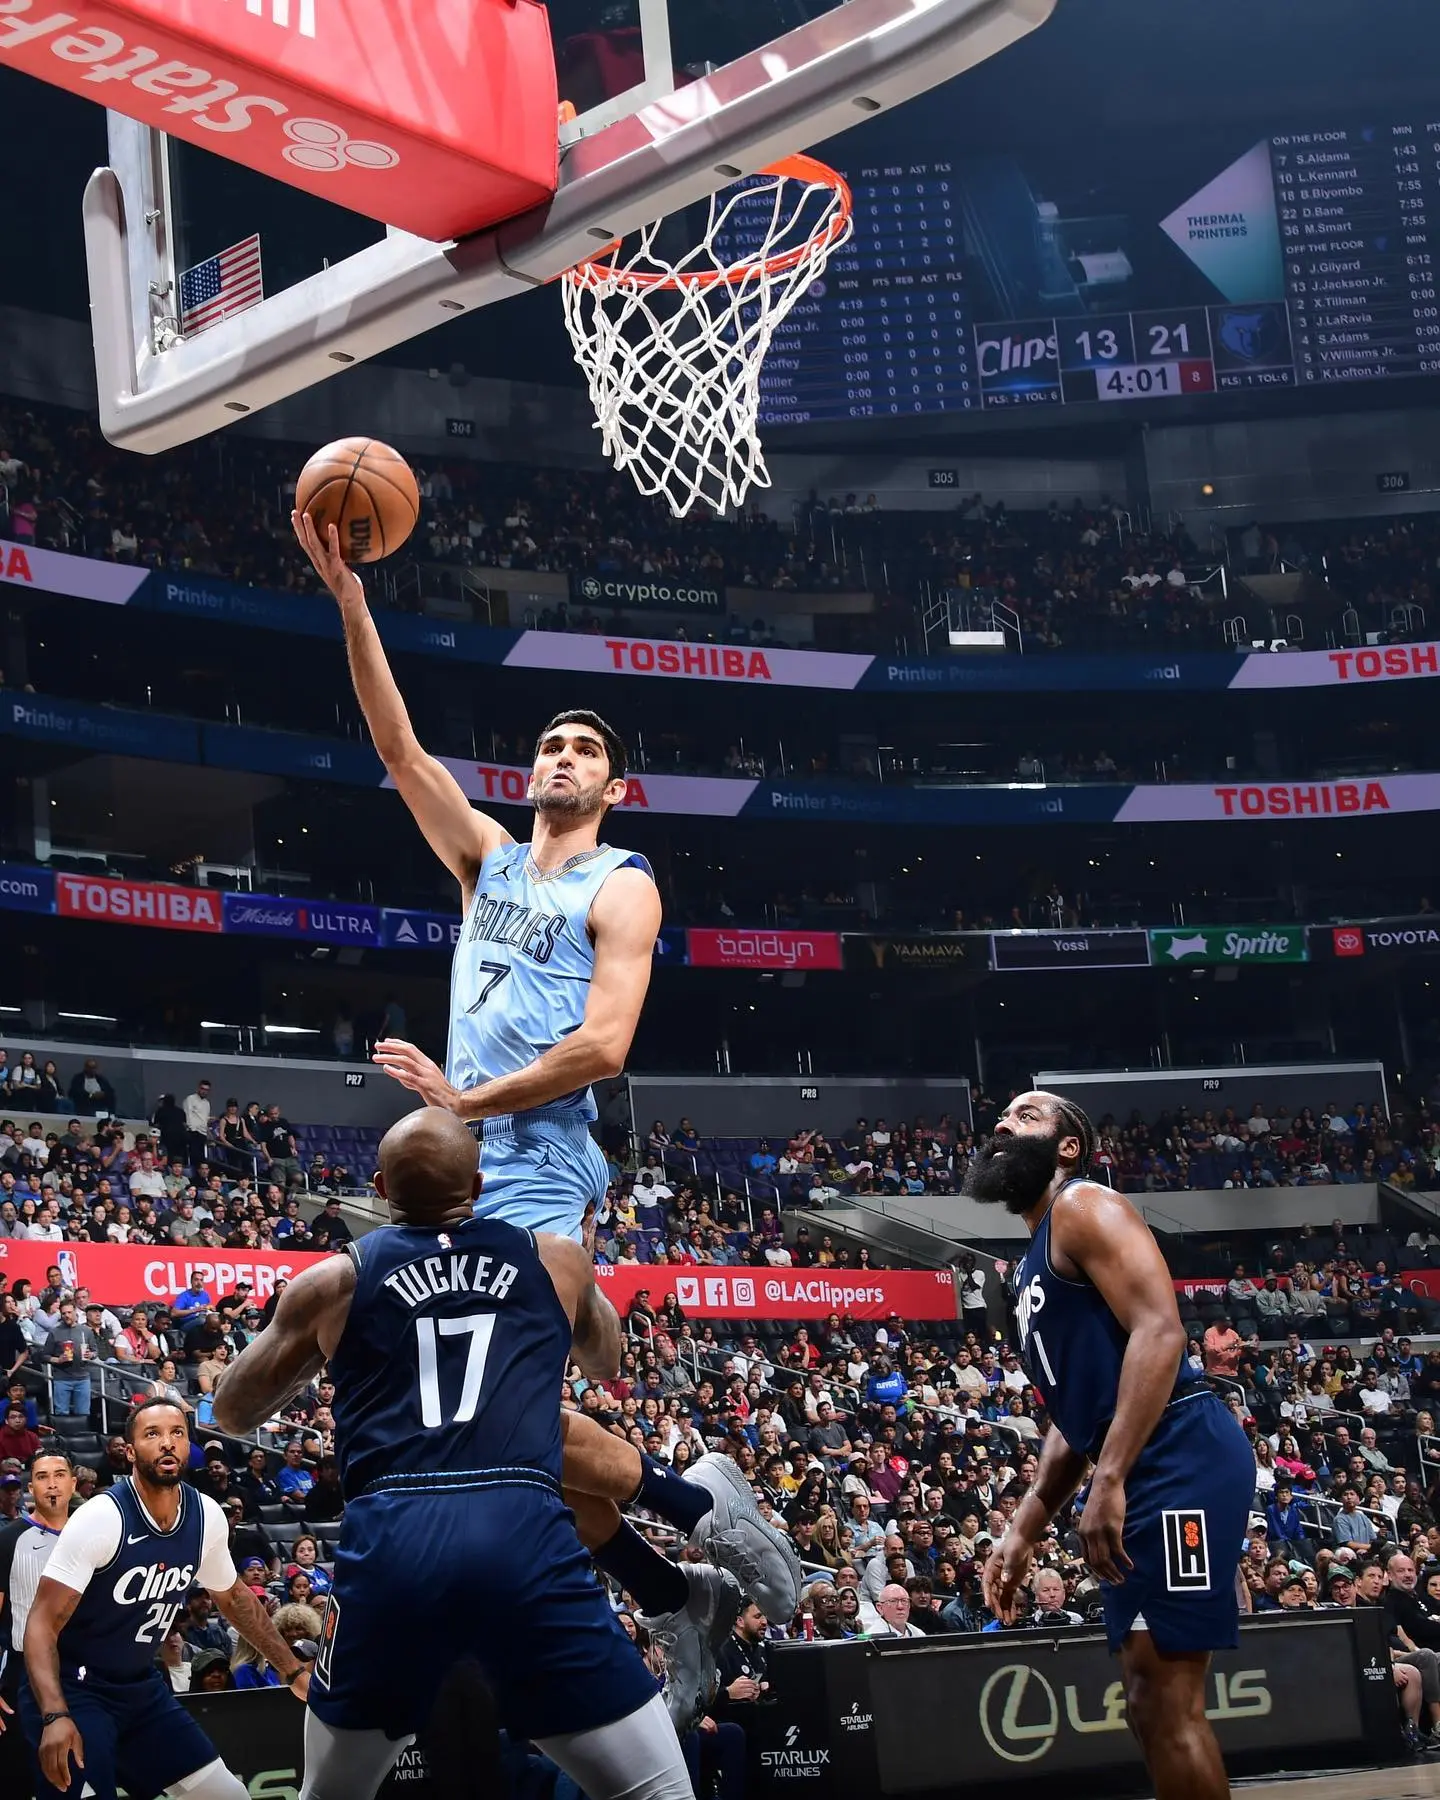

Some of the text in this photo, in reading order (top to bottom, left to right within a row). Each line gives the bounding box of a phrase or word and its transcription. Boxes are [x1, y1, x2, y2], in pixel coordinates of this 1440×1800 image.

[1273, 131, 1347, 146] ON THE FLOOR
[1392, 125, 1413, 135] MIN
[1296, 152, 1350, 164] S.Aldama
[1394, 145, 1417, 156] 1:43
[910, 165, 927, 174] AST
[935, 163, 951, 173] FLS
[1279, 163, 1419, 184] 10 L.Kennard 1:43
[1281, 180, 1421, 201] 18 B.Biyombo 7:55
[1283, 198, 1424, 220] 22 D.Bane 7:55
[1187, 213, 1246, 227] THERMAL
[1285, 215, 1426, 236] 36 M.Smart 7:55
[1189, 225, 1247, 240] PRINTERS
[1286, 235, 1426, 254] OFF THE FLOOR MIN
[835, 261, 860, 271] 3:36
[1310, 260, 1360, 274] J.Gilyard
[1407, 254, 1431, 265] 6:12
[839, 280, 859, 290] MIN
[920, 274, 938, 283] AST
[946, 272, 963, 281] FLS
[1292, 272, 1433, 292] 13 J.Jackson Jr. 6:12
[1313, 295, 1366, 308] X.Tillman
[1411, 289, 1435, 300] 0:00
[841, 317, 865, 328] 0:00
[1316, 313, 1372, 327] J.LaRavia
[1413, 307, 1437, 318] 0:00
[843, 335, 866, 346] 0:00
[1318, 332, 1370, 344] S.Adams
[1416, 325, 1440, 336] 0:00
[844, 352, 868, 363] 0:00
[978, 323, 1189, 377] Clips 13 21
[1320, 349, 1378, 362] V.Williams
[1382, 346, 1397, 357] Jr.
[846, 370, 870, 381] 0:00
[1107, 367, 1201, 394] 4:01 8
[1322, 366, 1371, 379] K.Lofton
[1375, 363, 1390, 375] Jr.
[848, 388, 872, 399] 0:00
[850, 405, 874, 416] 6:12
[934, 472, 953, 484] 305
[1382, 474, 1404, 488] 306
[604, 579, 719, 607] crypto.com
[606, 639, 772, 682] TOSHIBA
[888, 664, 943, 682] Printer
[12, 705, 74, 733] Printer
[772, 791, 826, 811] Printer
[1214, 783, 1390, 816] TOSHIBA
[64, 880, 215, 926] TOSHIBA
[311, 913, 375, 935] ULTRA
[716, 933, 814, 964] boldyn
[1053, 939, 1089, 953] Yossi
[1222, 935, 1289, 965] Sprite
[1367, 935, 1440, 952] TOYOTA
[466, 960, 511, 1014] 7
[346, 1074, 363, 1086] PR7
[1203, 1079, 1220, 1090] PR9
[801, 1088, 817, 1099] PR8
[384, 1255, 519, 1307] TUCKER
[934, 1273, 952, 1284] 103
[765, 1280, 884, 1309] @LAClippers
[416, 1313, 496, 1428] 17
[113, 1563, 193, 1605] Clips
[135, 1603, 180, 1643] 24
[1065, 1669, 1272, 1733] LEUS
[840, 1713, 873, 1725] STARLUX
[847, 1723, 869, 1731] AIRLINES
[760, 1749, 831, 1766] STARLUX
[773, 1766, 821, 1778] AIRLINES
